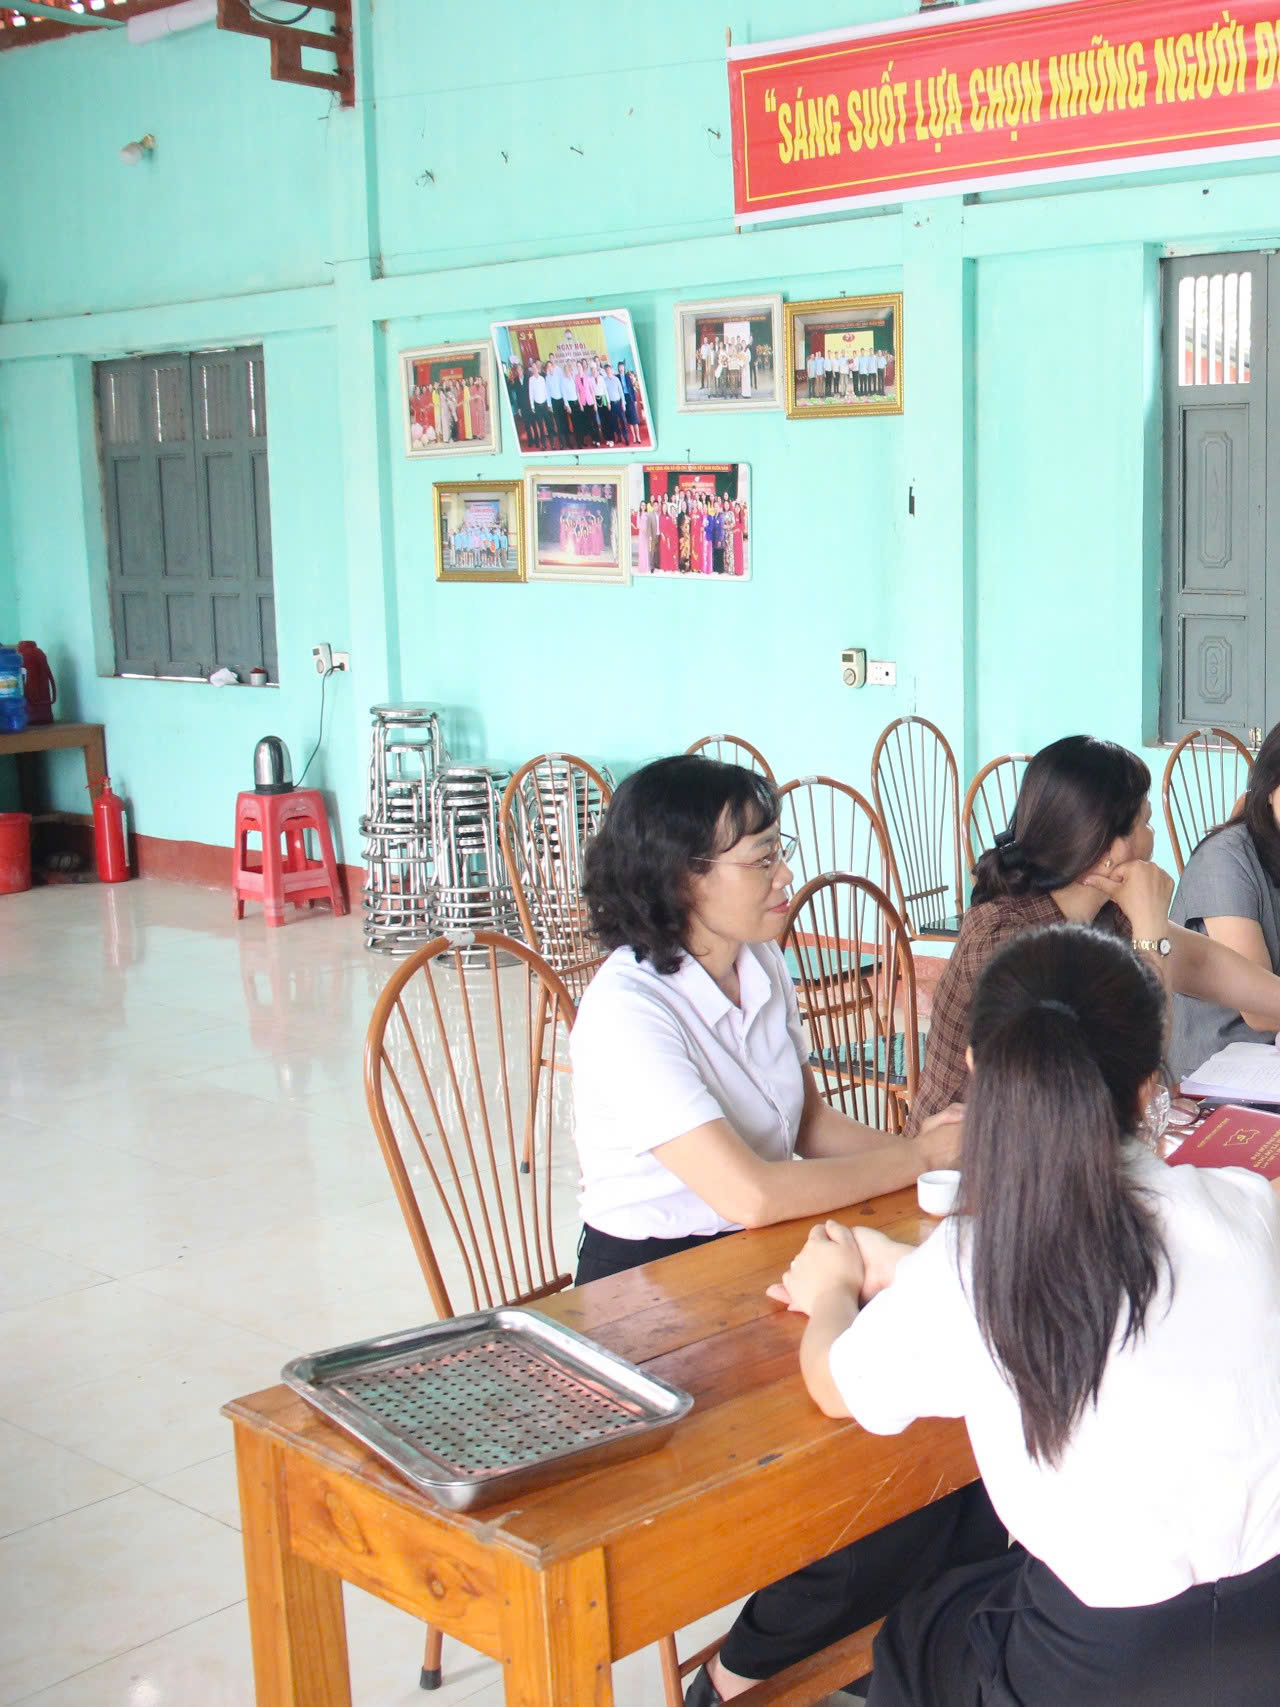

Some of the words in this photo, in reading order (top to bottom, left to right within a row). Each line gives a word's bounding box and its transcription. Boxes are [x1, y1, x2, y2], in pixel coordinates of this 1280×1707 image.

[847, 60, 907, 152] SUỐT
[914, 67, 963, 153] LỰA
[969, 58, 1043, 142] CHỌN
[1049, 34, 1148, 119] NHỮNG
[1154, 10, 1248, 105] NGƯỜI
